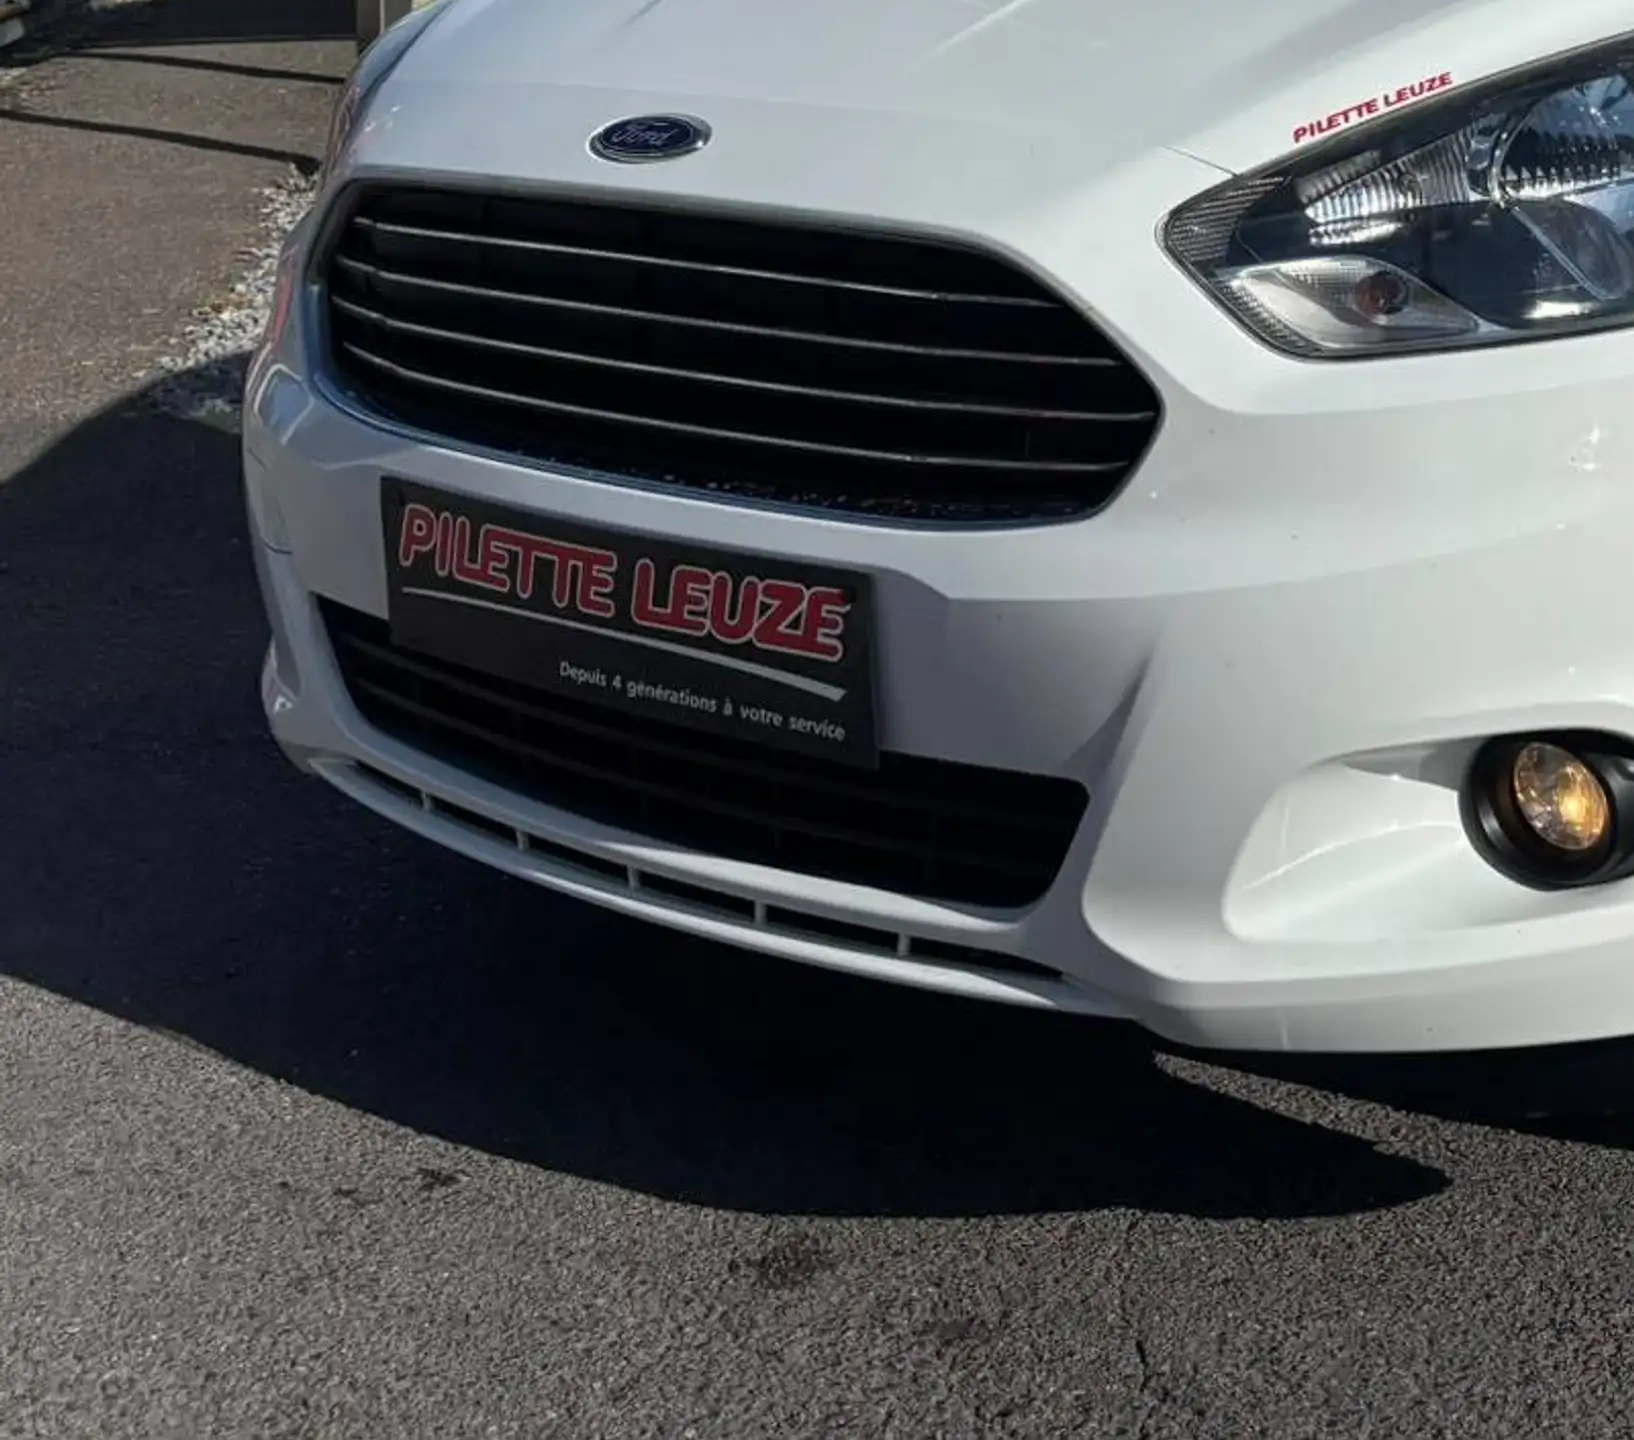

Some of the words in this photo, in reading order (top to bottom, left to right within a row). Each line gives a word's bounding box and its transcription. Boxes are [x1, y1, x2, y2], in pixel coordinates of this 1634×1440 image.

[1293, 98, 1380, 143] PILETTE
[1384, 72, 1454, 107] LEUZE
[400, 503, 618, 618] PILETTE
[632, 558, 854, 662] LEUZE
[559, 661, 607, 687] Depuis
[612, 674, 622, 692] 4
[627, 679, 718, 713] générations
[723, 697, 733, 716] à
[739, 705, 783, 728] votre
[788, 715, 846, 742] service
